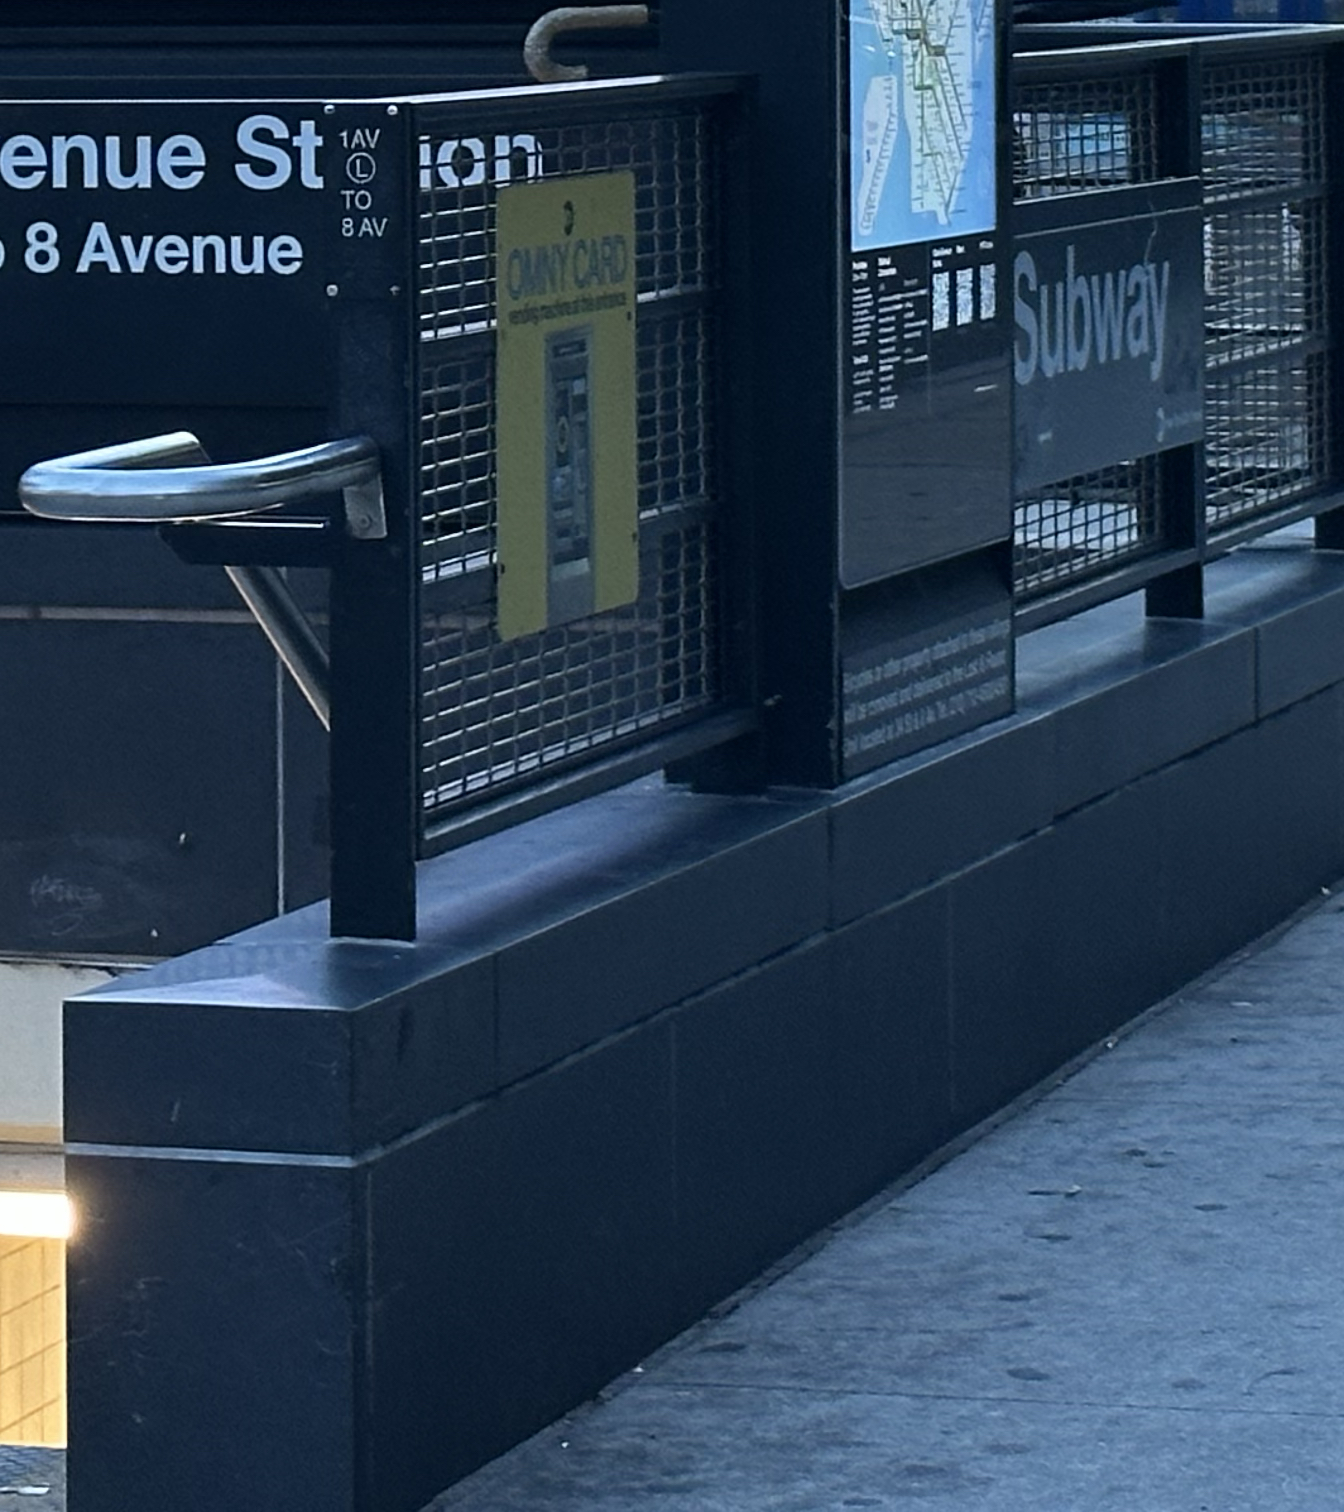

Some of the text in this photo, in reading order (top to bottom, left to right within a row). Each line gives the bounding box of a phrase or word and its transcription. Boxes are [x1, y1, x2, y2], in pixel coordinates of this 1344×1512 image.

[235, 114, 544, 190] Stion
[340, 190, 372, 210] TO
[341, 217, 388, 237] 8 AV
[24, 221, 60, 274] 8
[75, 221, 304, 275] Avenue
[573, 234, 627, 290] CARD
[1014, 244, 1171, 386] Subway
